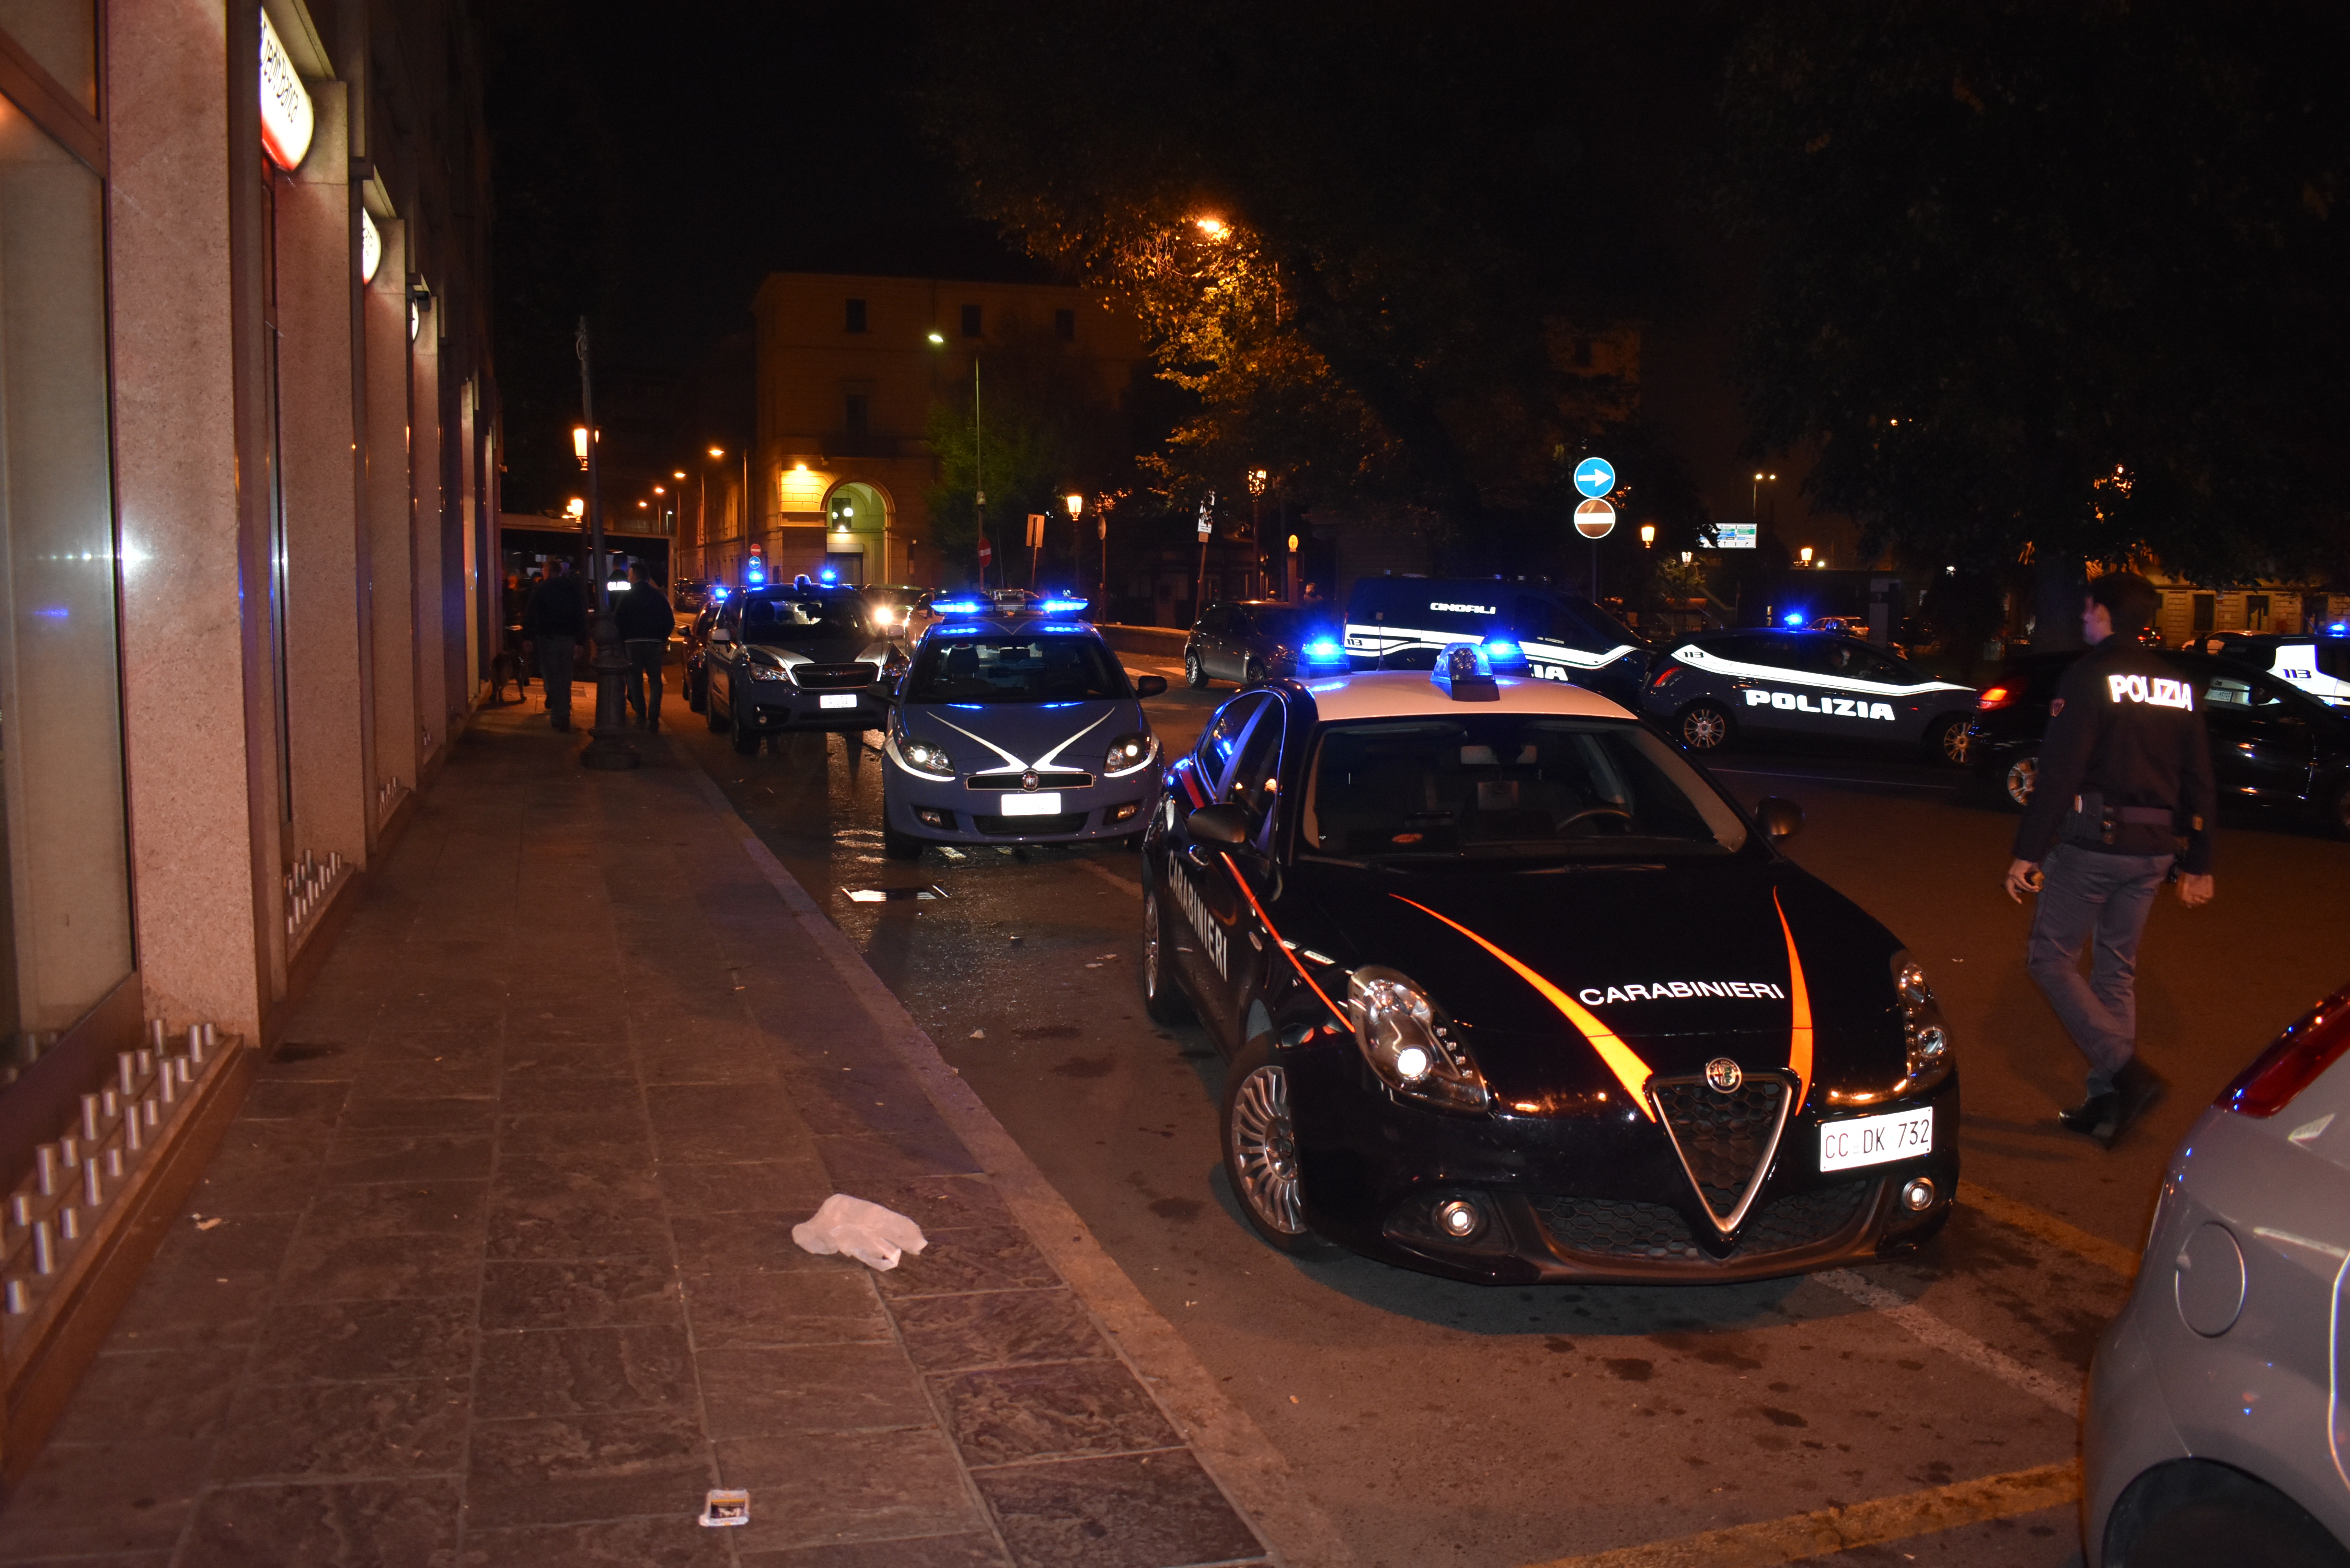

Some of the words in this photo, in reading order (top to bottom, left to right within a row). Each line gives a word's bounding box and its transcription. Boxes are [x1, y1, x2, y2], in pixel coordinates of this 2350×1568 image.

[277, 56, 298, 123] Banca
[1430, 603, 1496, 614] CINOFILI
[2283, 669, 2311, 679] 113
[1745, 689, 1895, 721] POLIZIA
[2109, 675, 2193, 711] POLIZIA
[1168, 849, 1227, 982] CARABINIERI
[1580, 981, 1784, 1005] CARABINIERI
[1825, 1135, 1849, 1159] CC
[1863, 1127, 1885, 1154] DK
[1898, 1119, 1929, 1148] 732
